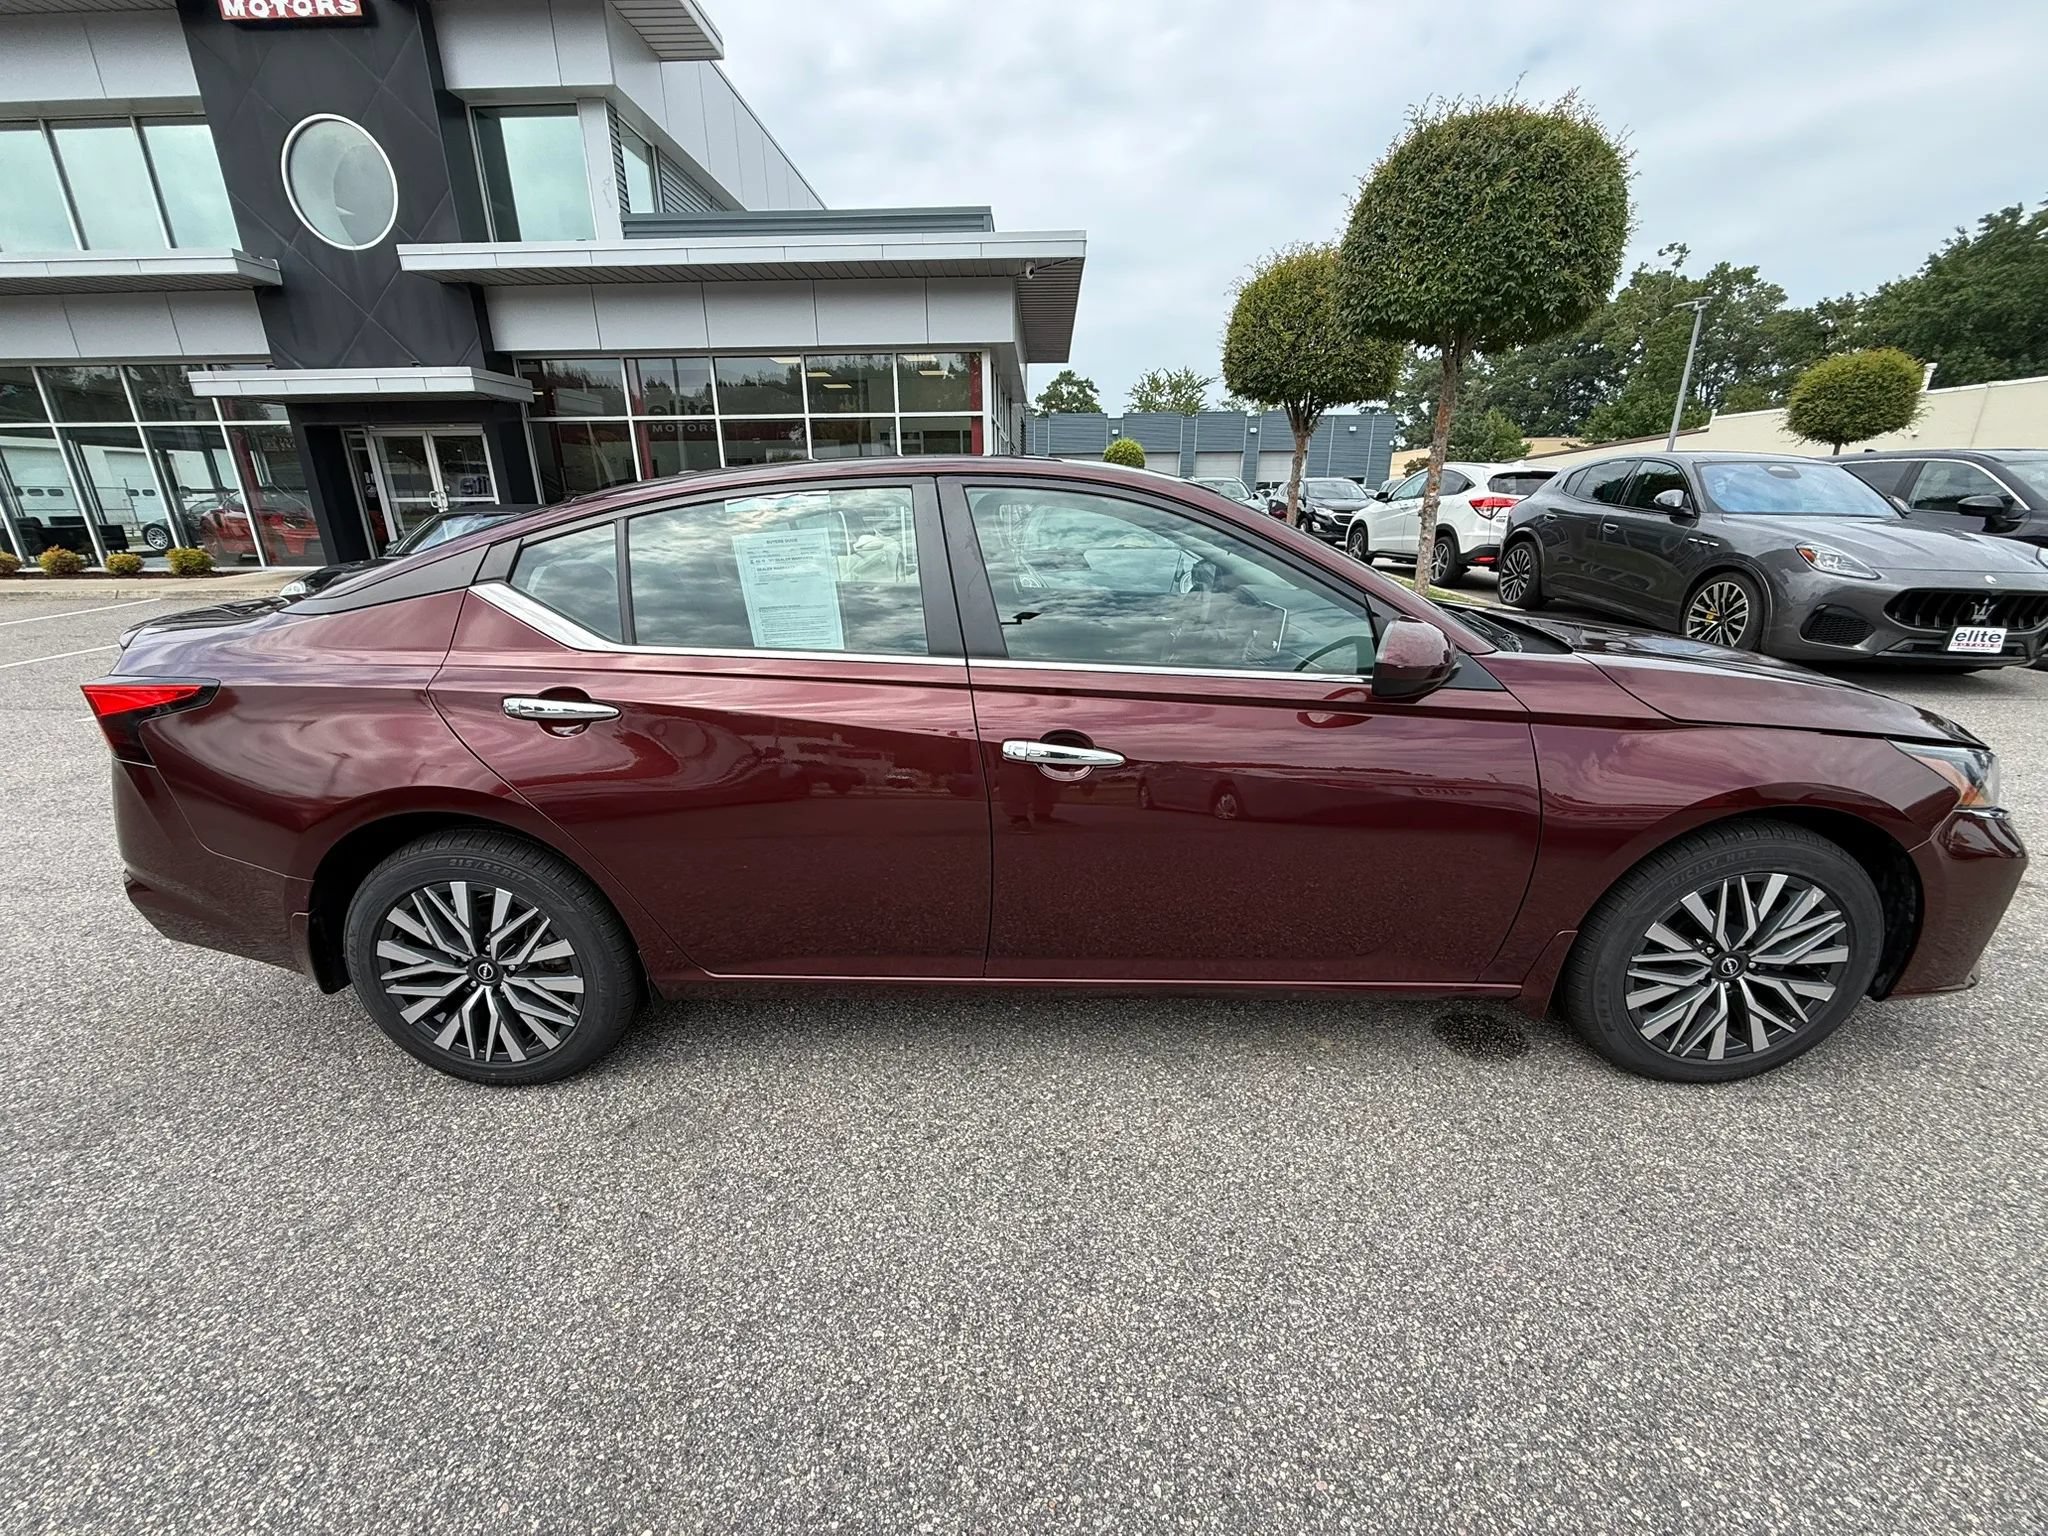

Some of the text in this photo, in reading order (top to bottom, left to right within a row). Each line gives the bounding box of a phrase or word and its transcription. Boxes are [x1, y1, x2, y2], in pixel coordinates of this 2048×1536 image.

[222, 0, 357, 17] MOTORS
[652, 423, 716, 433] MOTORS
[1955, 630, 2002, 643] elite
